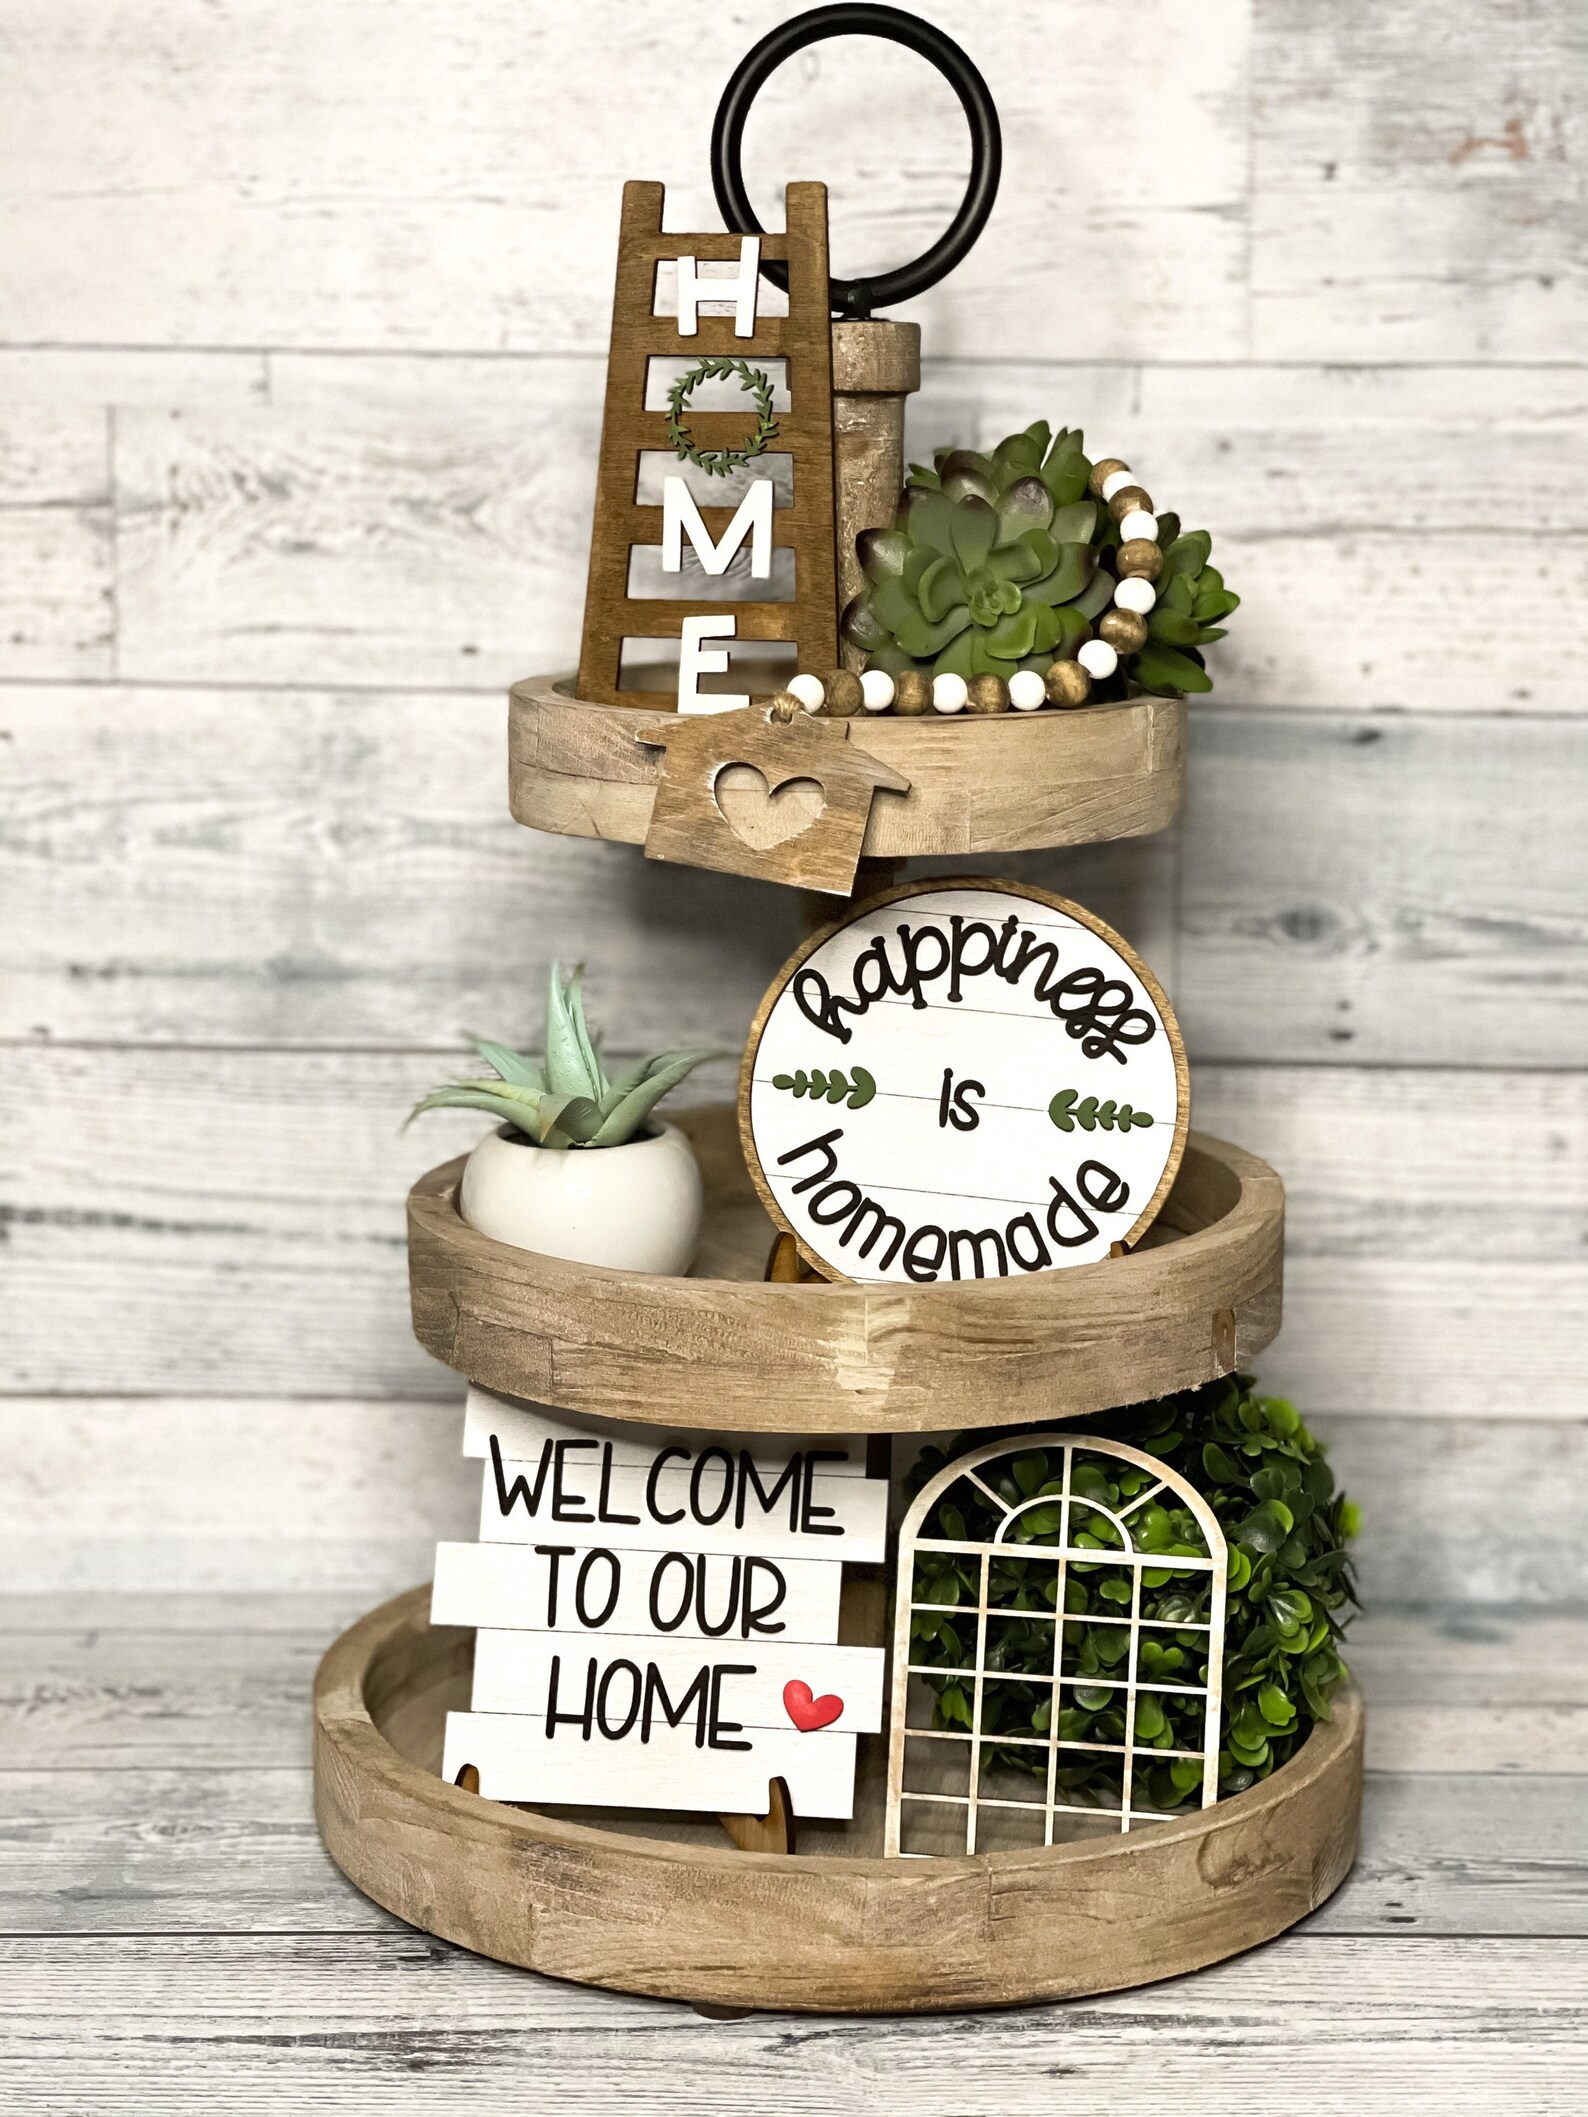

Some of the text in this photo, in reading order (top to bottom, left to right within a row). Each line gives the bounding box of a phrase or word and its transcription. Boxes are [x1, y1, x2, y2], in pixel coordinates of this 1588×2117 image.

[793, 915, 1156, 1065] happiness
[939, 1068, 985, 1131] is
[777, 1128, 1130, 1282] homemade
[489, 1434, 849, 1535] WELCOME
[535, 1545, 787, 1638] TO OUR
[545, 1655, 757, 1751] HOME
